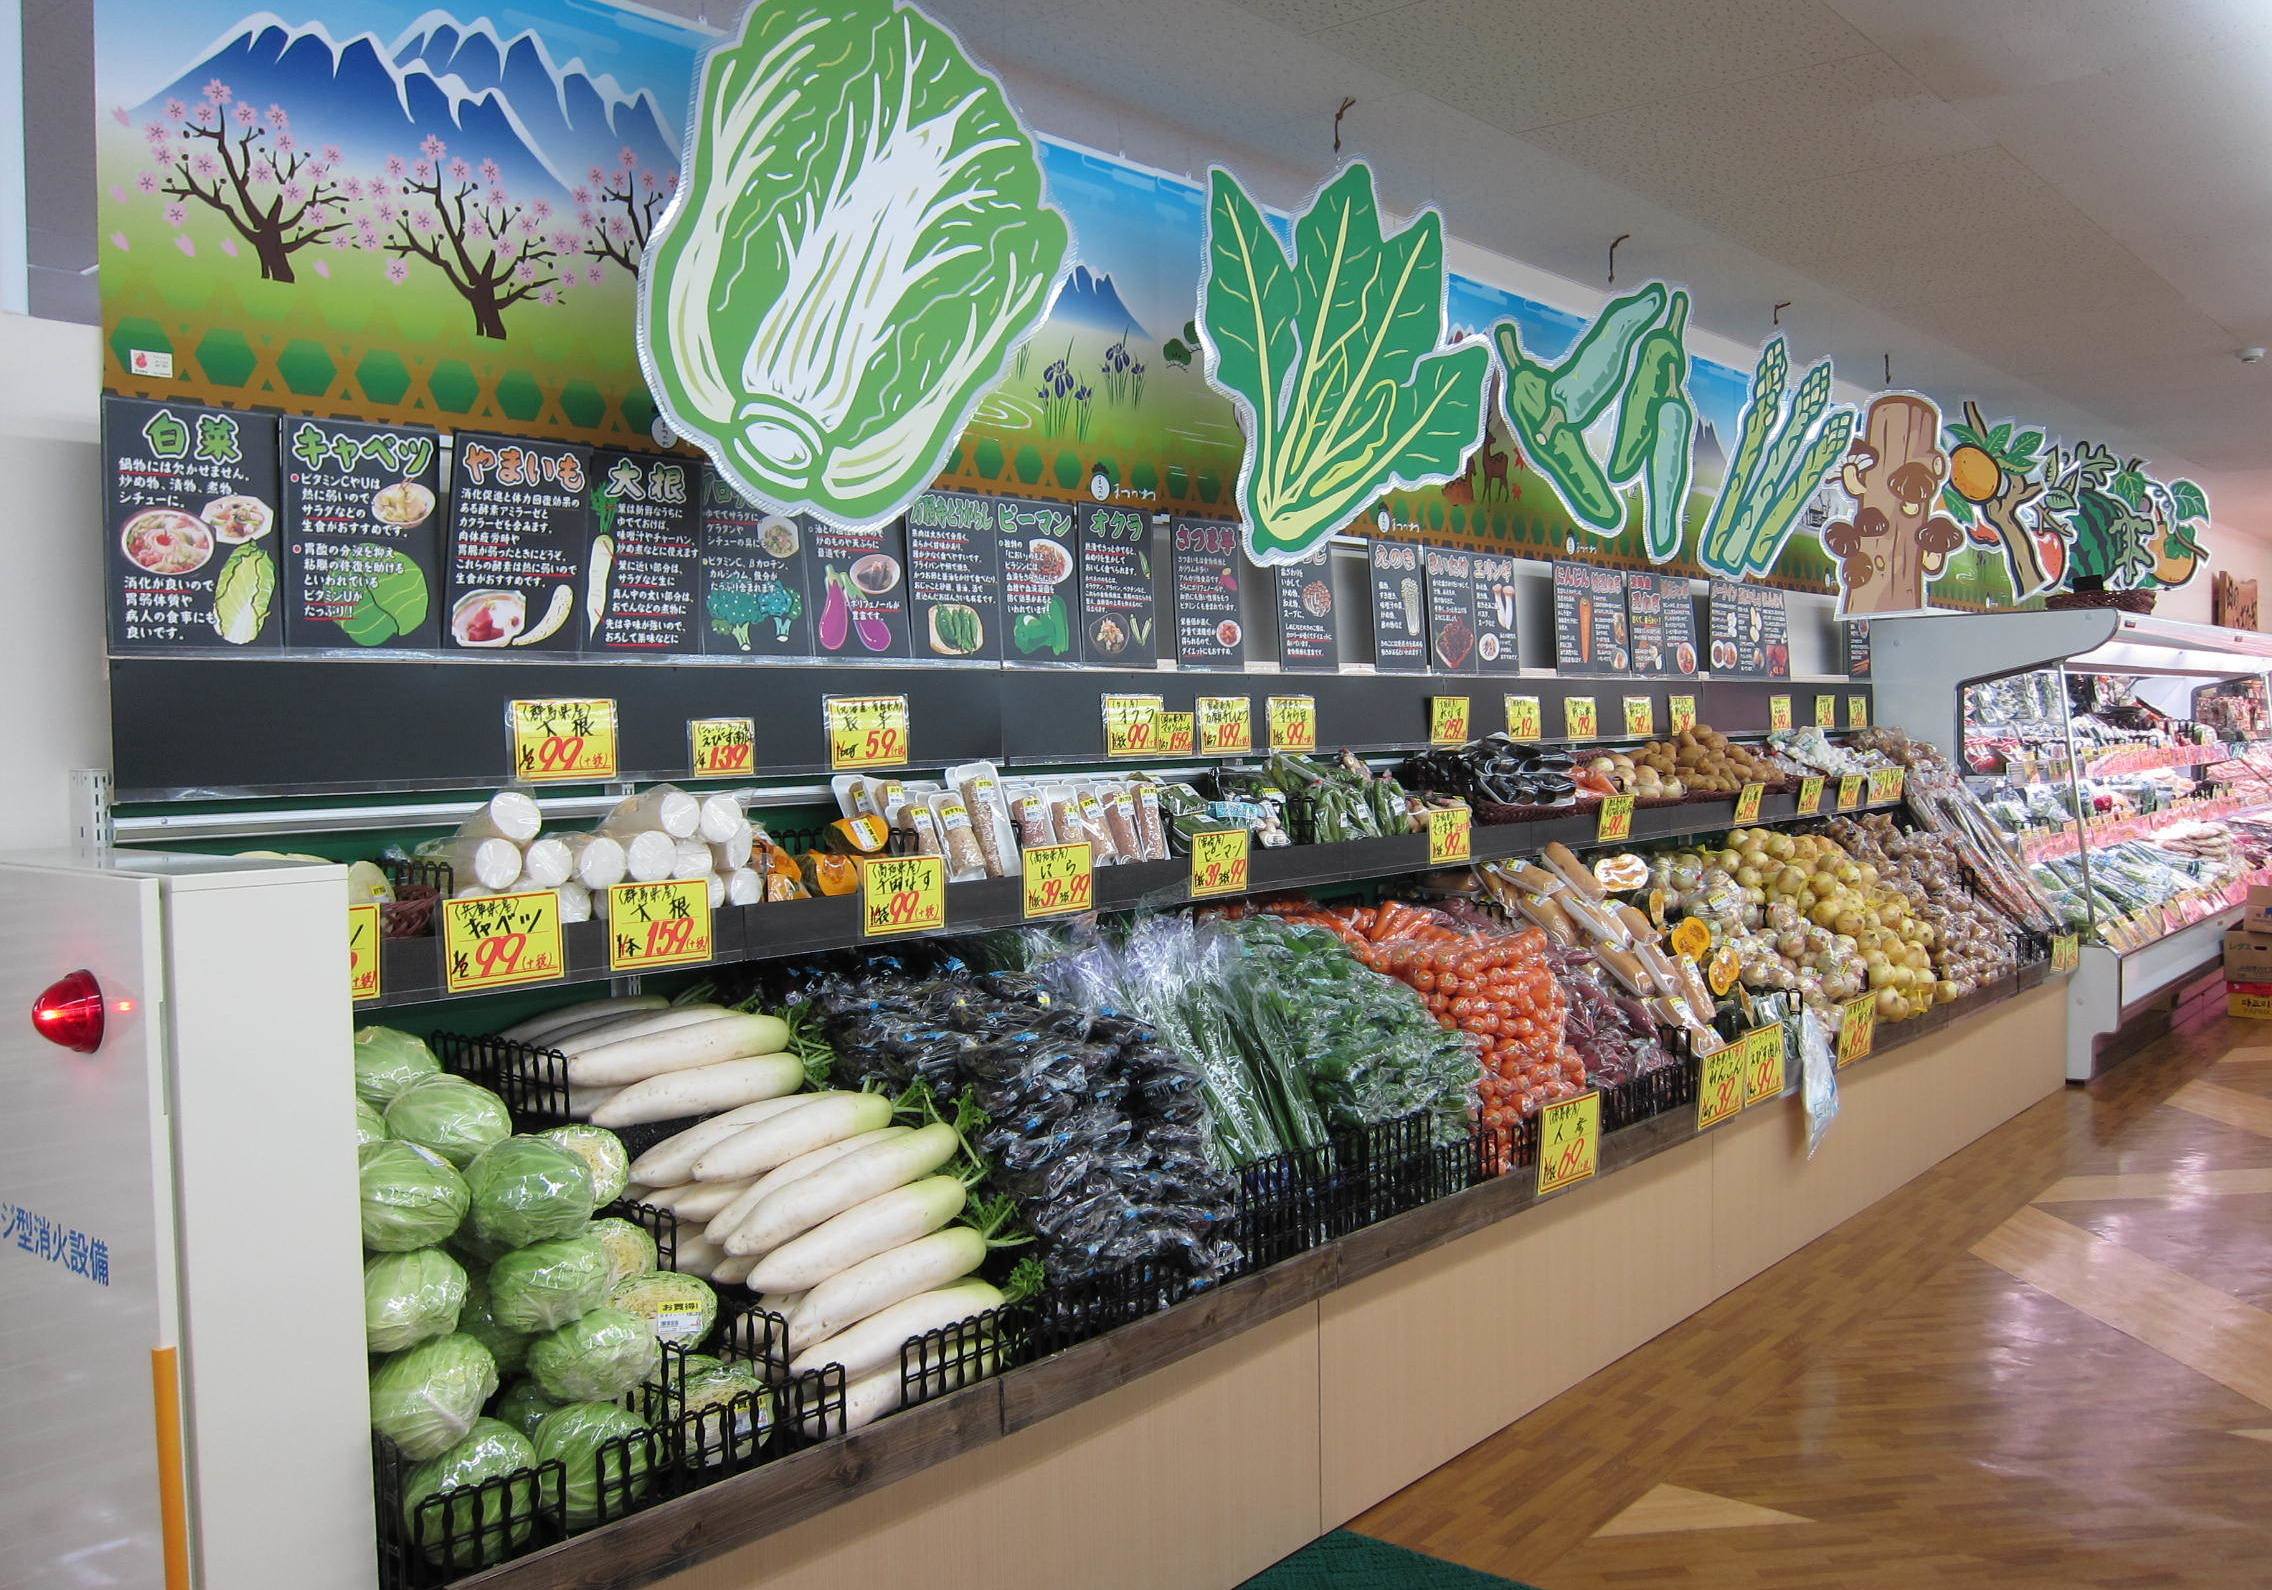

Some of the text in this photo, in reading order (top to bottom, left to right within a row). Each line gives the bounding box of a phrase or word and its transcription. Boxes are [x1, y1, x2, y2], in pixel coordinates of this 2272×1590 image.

[142, 408, 242, 465] 白菜
[292, 422, 434, 477] キャベツ
[463, 441, 586, 493] やまいも
[604, 457, 687, 504] 大根
[301, 473, 380, 489] ビタミンCやUは
[302, 504, 366, 519] サラダなどの
[997, 503, 1072, 537] ピーマン
[1089, 509, 1143, 541] オクラ
[124, 576, 215, 592] 消化が良いので
[304, 573, 378, 588] といわれている
[304, 589, 362, 602] ビタミンUが
[125, 609, 219, 625] 病人の食事にも
[536, 716, 595, 738] 大根
[1126, 723, 1150, 750] 99
[1170, 731, 1189, 750] 159
[1218, 722, 1241, 747] 199
[1286, 721, 1306, 746] 99
[538, 736, 584, 771] 99
[709, 743, 749, 769] 139
[865, 728, 898, 760] 59
[1445, 832, 1460, 856] 99
[1040, 860, 1076, 880] にら
[1205, 862, 1221, 886] 39
[1231, 859, 1246, 883] 99
[1041, 879, 1062, 907] 39
[1069, 873, 1090, 902] 99
[630, 896, 690, 922] 大根
[889, 891, 920, 924] 99
[464, 909, 542, 938] キャベツ
[644, 919, 695, 958] 159
[475, 933, 526, 976] 99
[1757, 1058, 1775, 1095] 99
[1715, 1076, 1736, 1114] 39
[1557, 1138, 1585, 1179] 69
